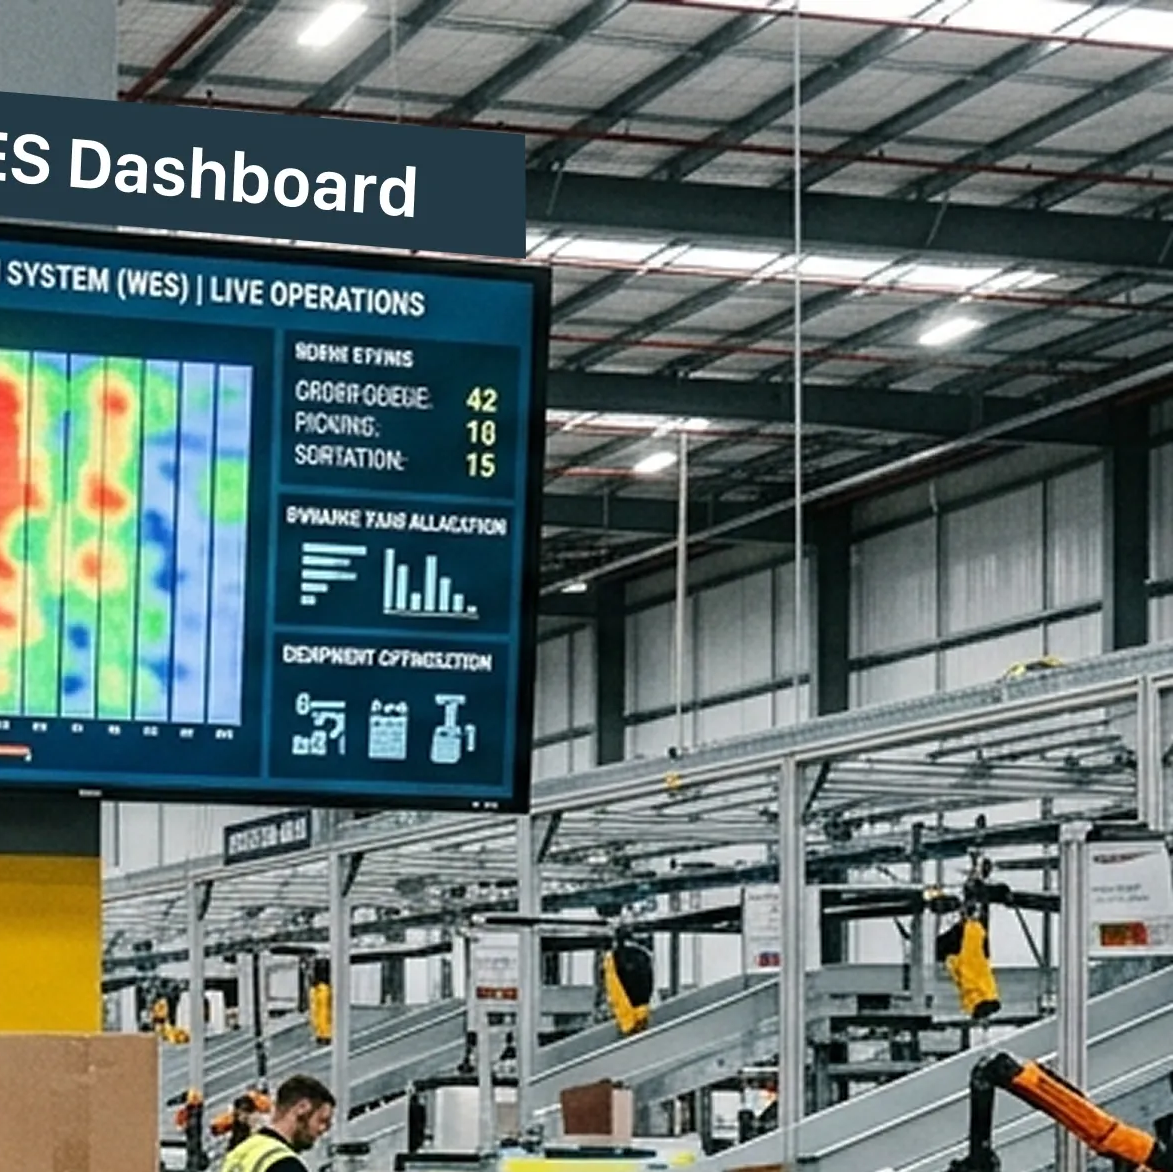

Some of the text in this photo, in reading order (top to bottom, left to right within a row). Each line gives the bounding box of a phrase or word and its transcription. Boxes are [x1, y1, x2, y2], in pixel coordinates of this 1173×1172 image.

[69, 138, 417, 218] Dashboard
[7, 260, 110, 293] SYSTEM
[117, 267, 189, 305] (WES)
[210, 276, 264, 306] LIVE
[270, 280, 426, 317] OPERATIONS
[466, 387, 498, 413] 42
[466, 452, 497, 478] 15
